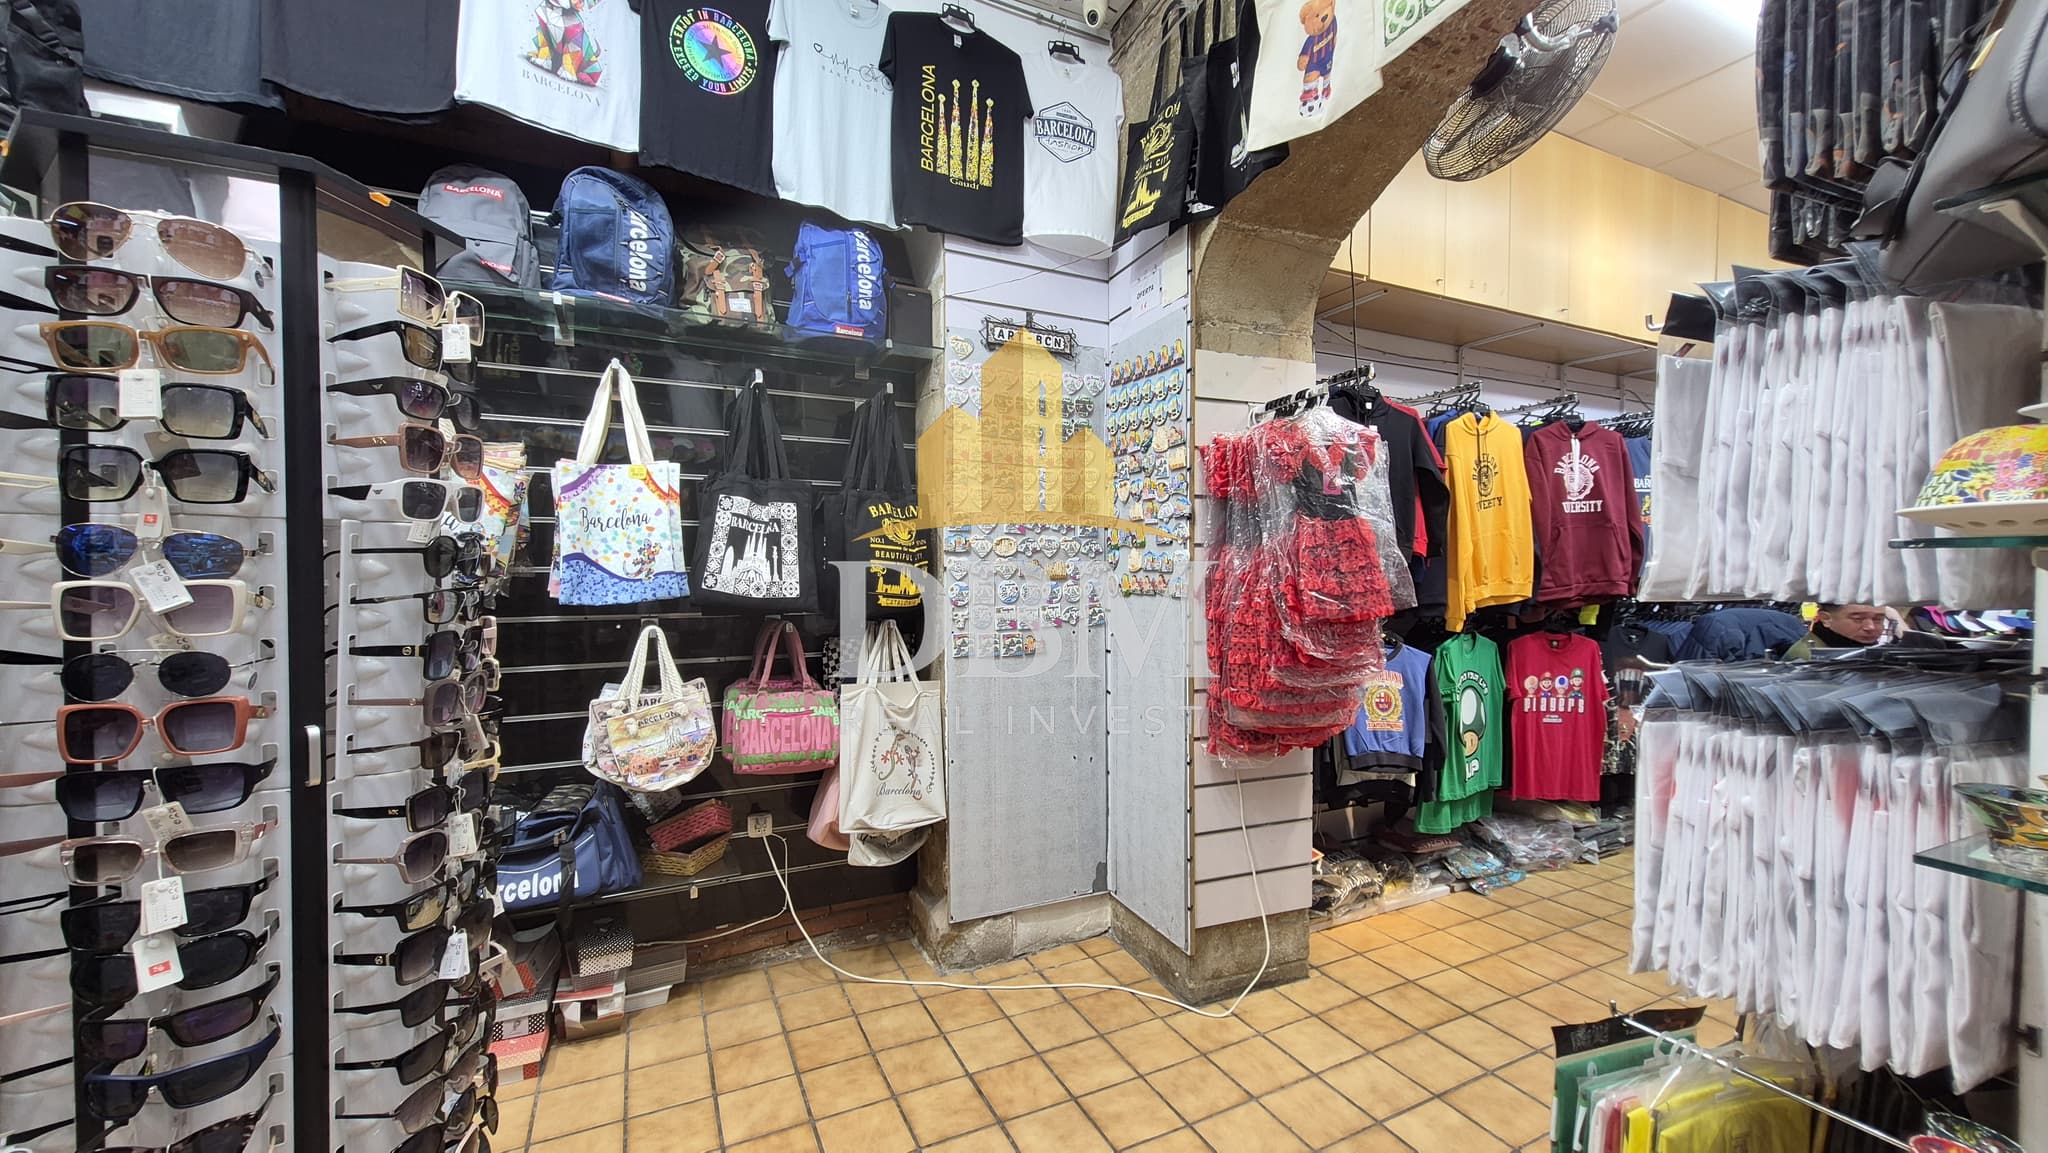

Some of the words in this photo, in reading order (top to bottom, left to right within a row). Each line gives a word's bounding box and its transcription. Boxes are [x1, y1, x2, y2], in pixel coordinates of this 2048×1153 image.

[673, 12, 695, 39] ENJOY
[697, 10, 709, 20] IN
[713, 12, 755, 61] BARCELONA
[673, 46, 700, 81] EXCEED
[702, 78, 727, 92] YOUR
[728, 65, 754, 91] LIMITS
[920, 64, 936, 172] BARCELONA
[1036, 119, 1095, 148] BARCELONA
[579, 506, 651, 533] Barcelona
[740, 717, 832, 756] BARCELONA
